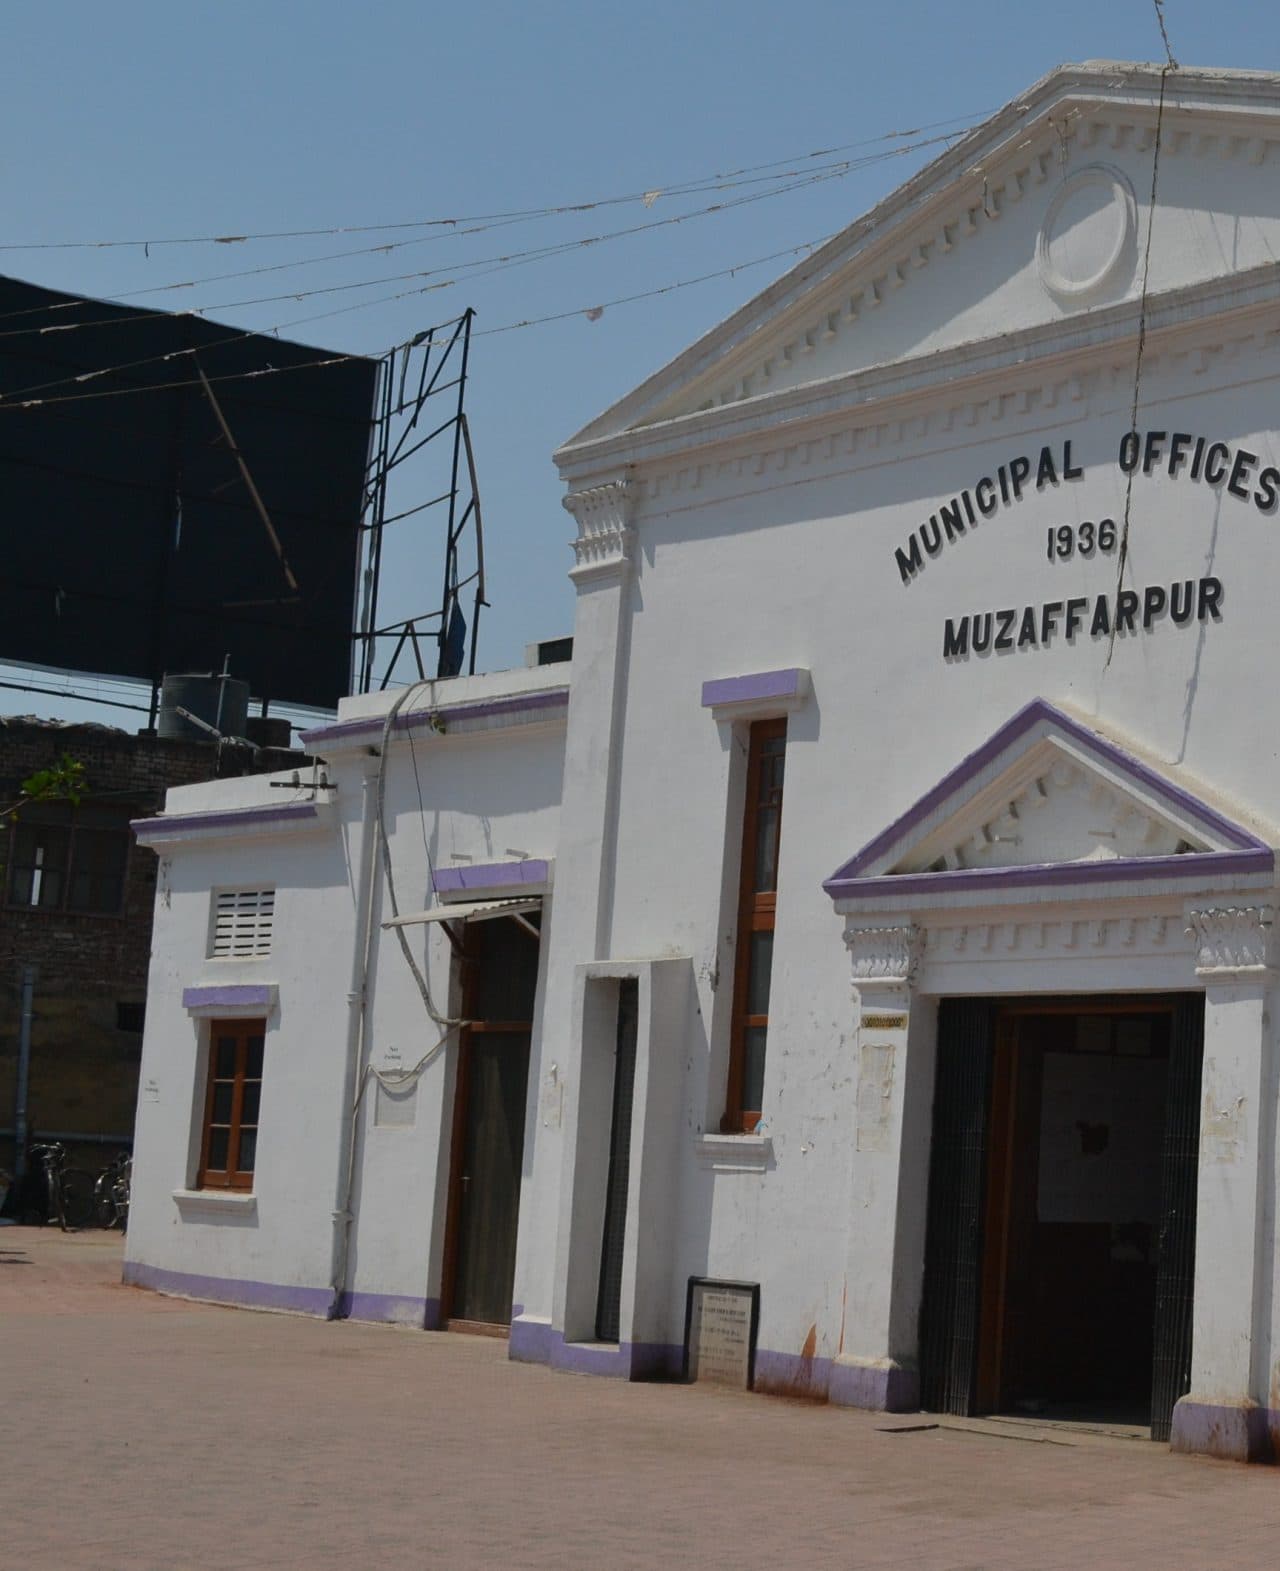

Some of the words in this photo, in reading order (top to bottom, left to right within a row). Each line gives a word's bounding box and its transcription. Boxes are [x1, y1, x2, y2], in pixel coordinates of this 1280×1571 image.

[894, 440, 1083, 583] MUNICIPAL
[1047, 519, 1116, 559] 1936
[943, 577, 1223, 658] MUZAFFARPUR
